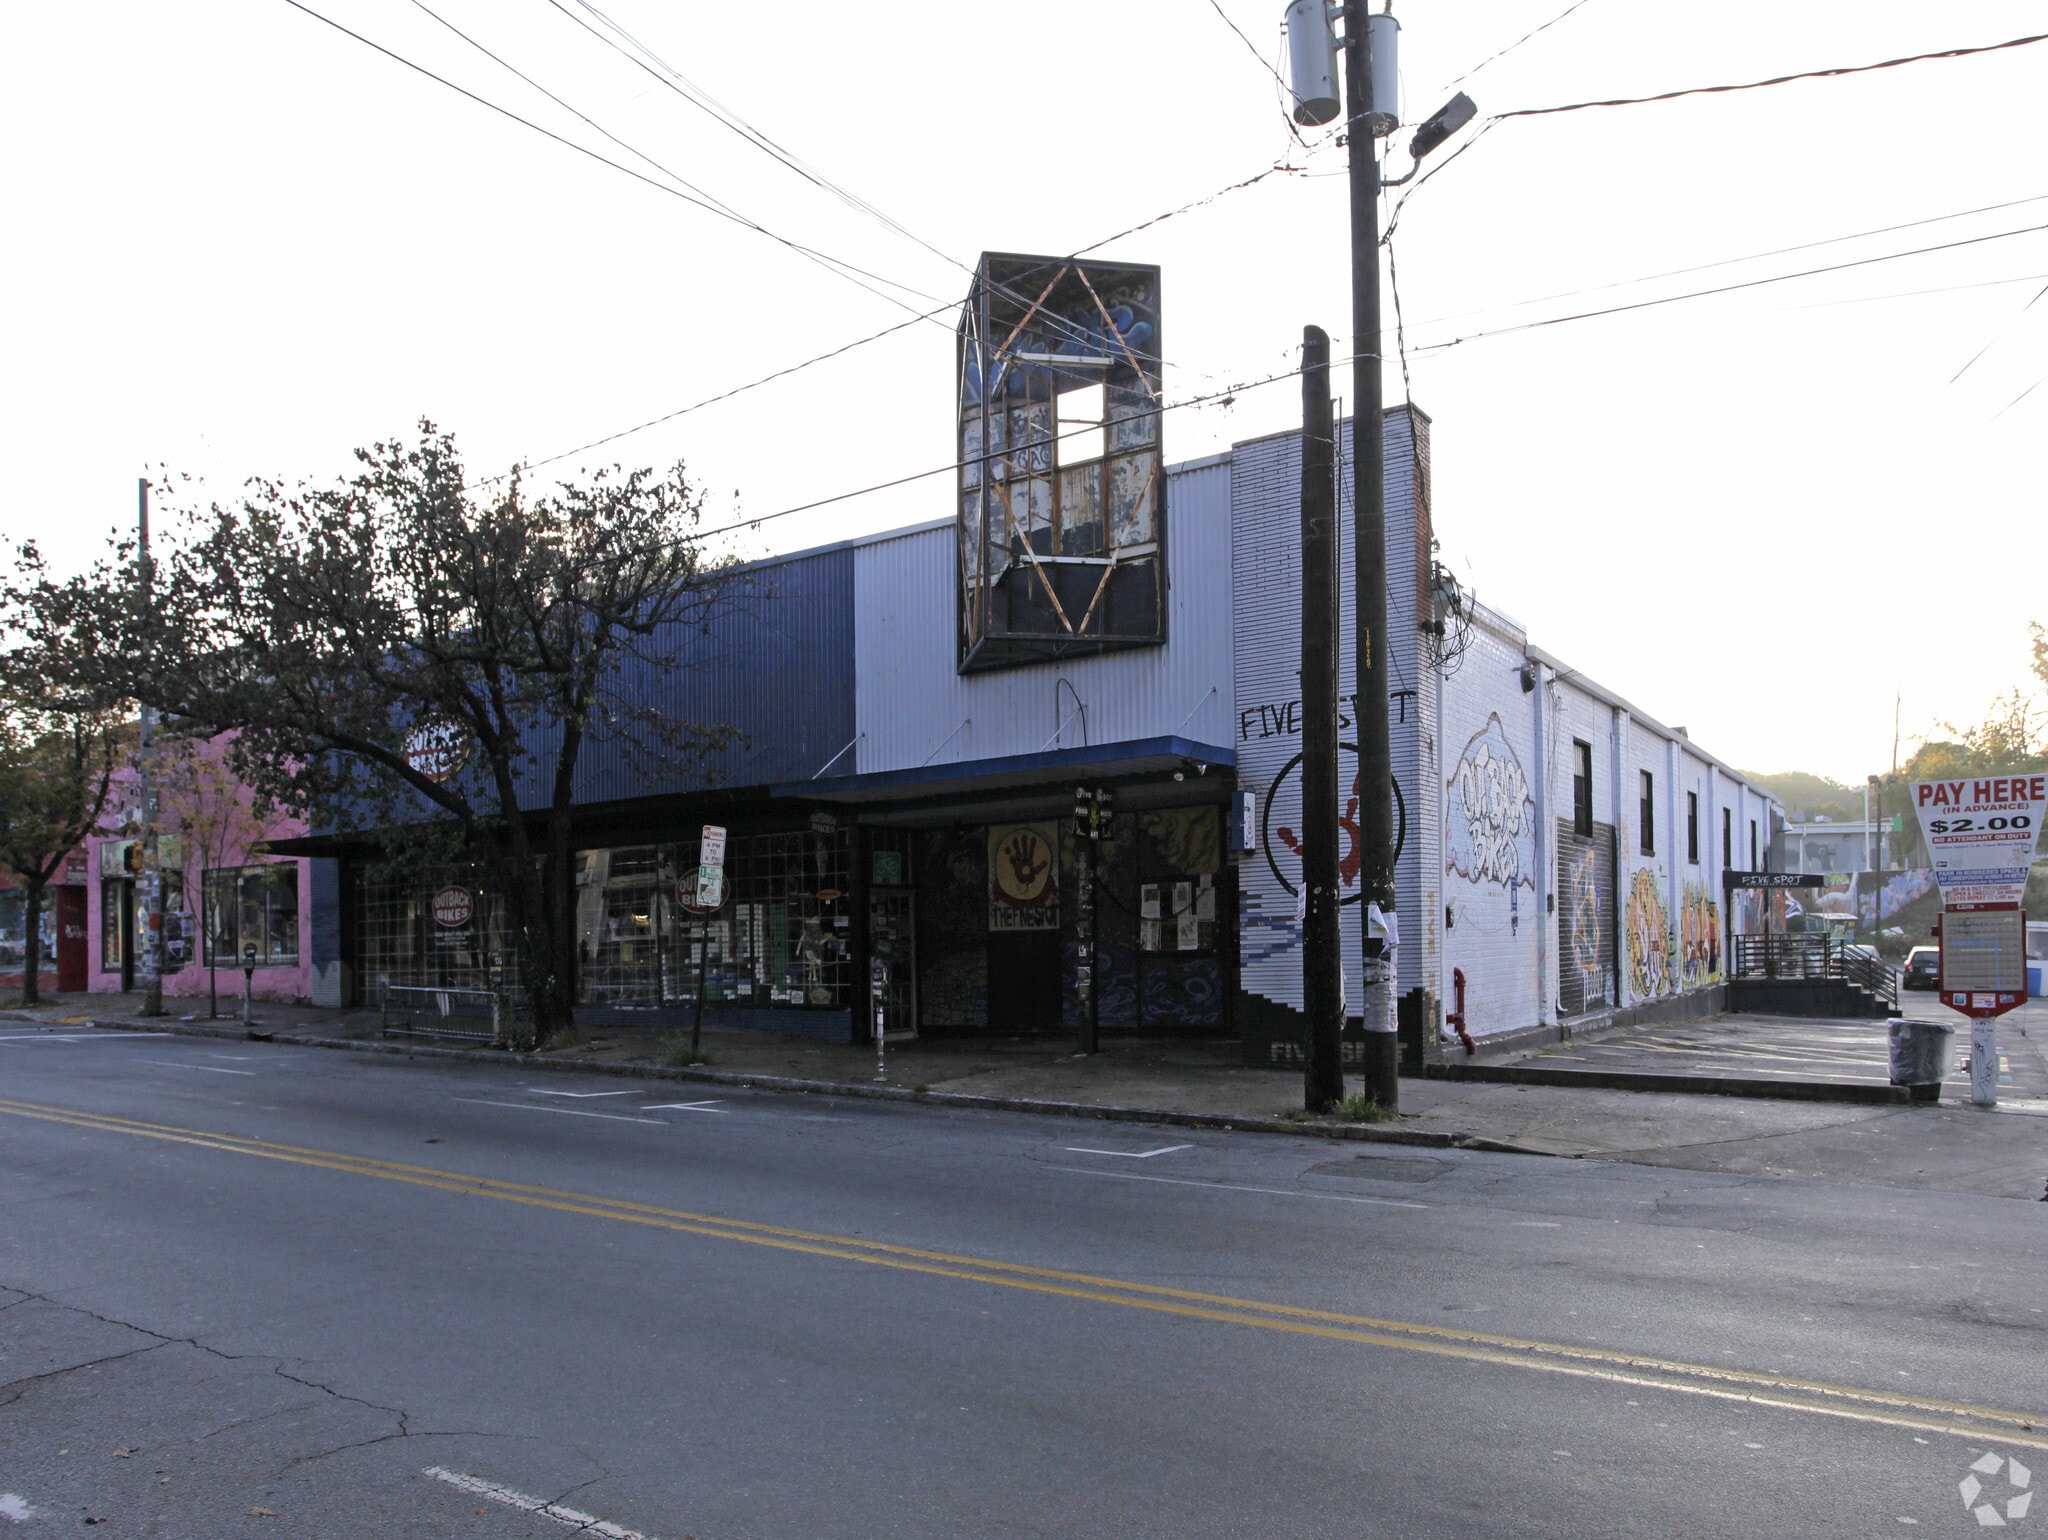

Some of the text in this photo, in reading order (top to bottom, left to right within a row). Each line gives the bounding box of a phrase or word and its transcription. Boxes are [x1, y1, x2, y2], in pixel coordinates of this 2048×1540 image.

[1241, 698, 1303, 741] FIVE
[1918, 777, 2045, 807] PAY HERE
[1943, 803, 2029, 814] (IN ADVANCE)
[1930, 816, 2031, 834] $2.00
[1742, 875, 1804, 884] FIVE SPOT
[435, 891, 470, 908] OUTBACK
[436, 908, 469, 921] BIKES
[1271, 1042, 1305, 1062] FIV
